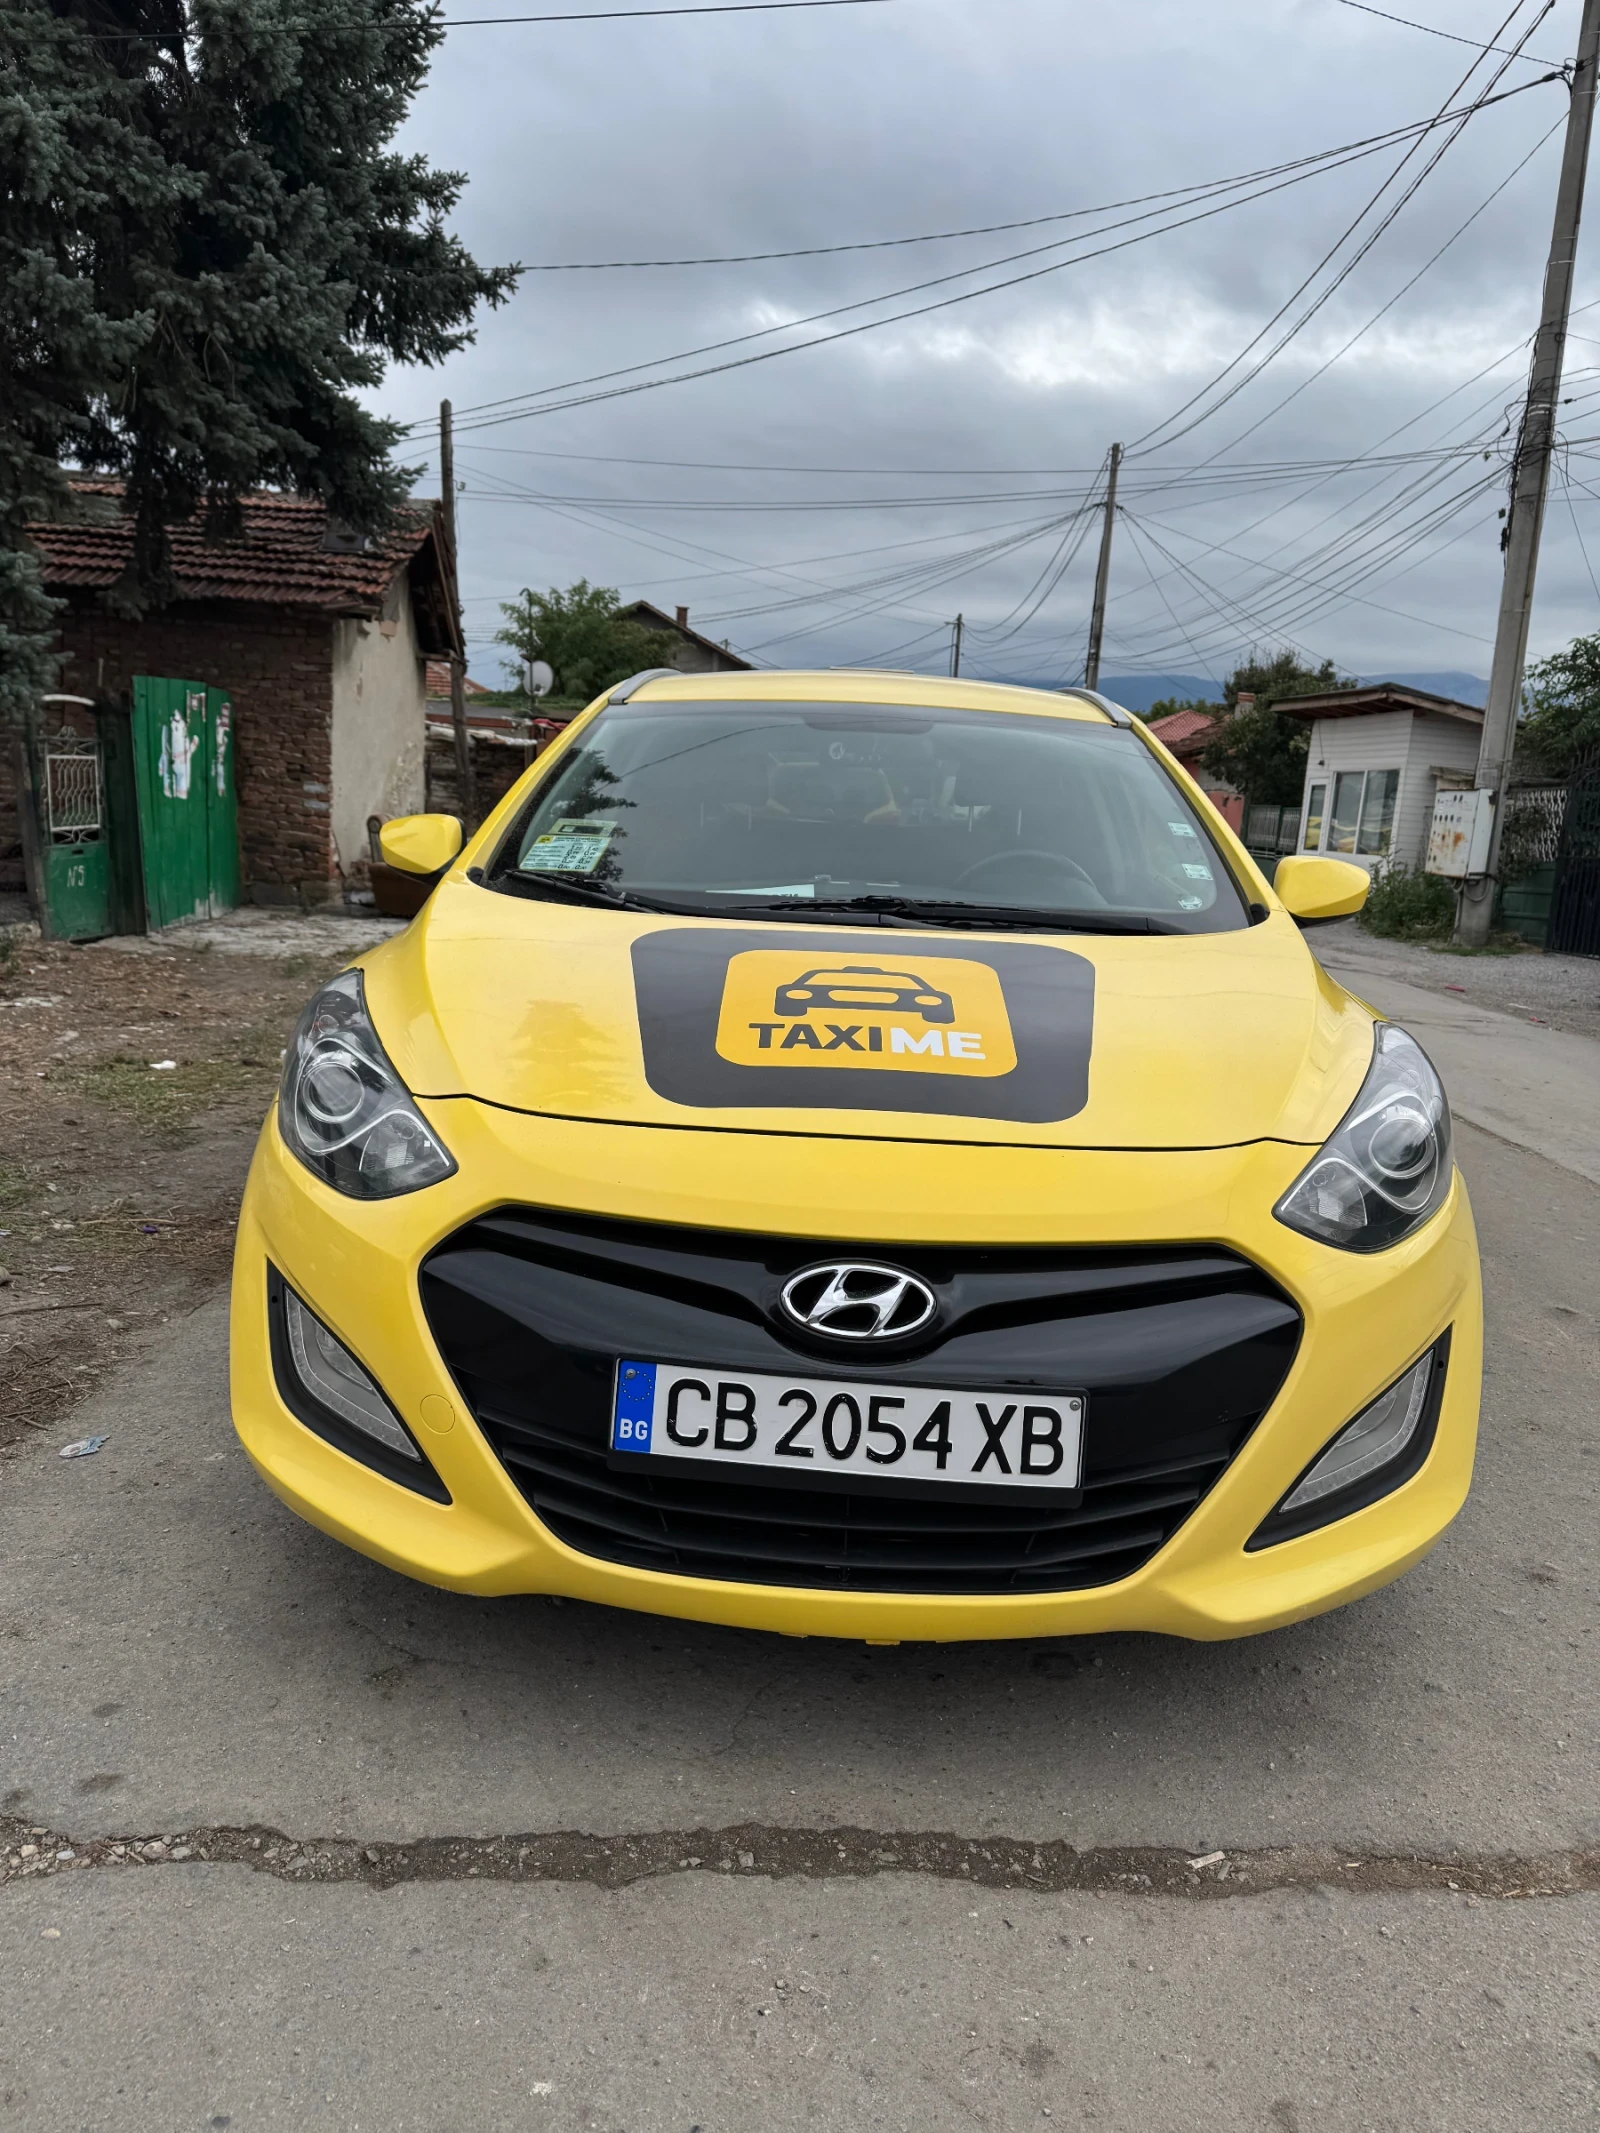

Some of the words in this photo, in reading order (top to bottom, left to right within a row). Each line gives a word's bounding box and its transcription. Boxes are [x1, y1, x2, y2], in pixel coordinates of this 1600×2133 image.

[619, 1418, 648, 1440] BG
[667, 1378, 757, 1450] CB
[774, 1389, 953, 1469] 2054
[971, 1402, 1064, 1475] XB
